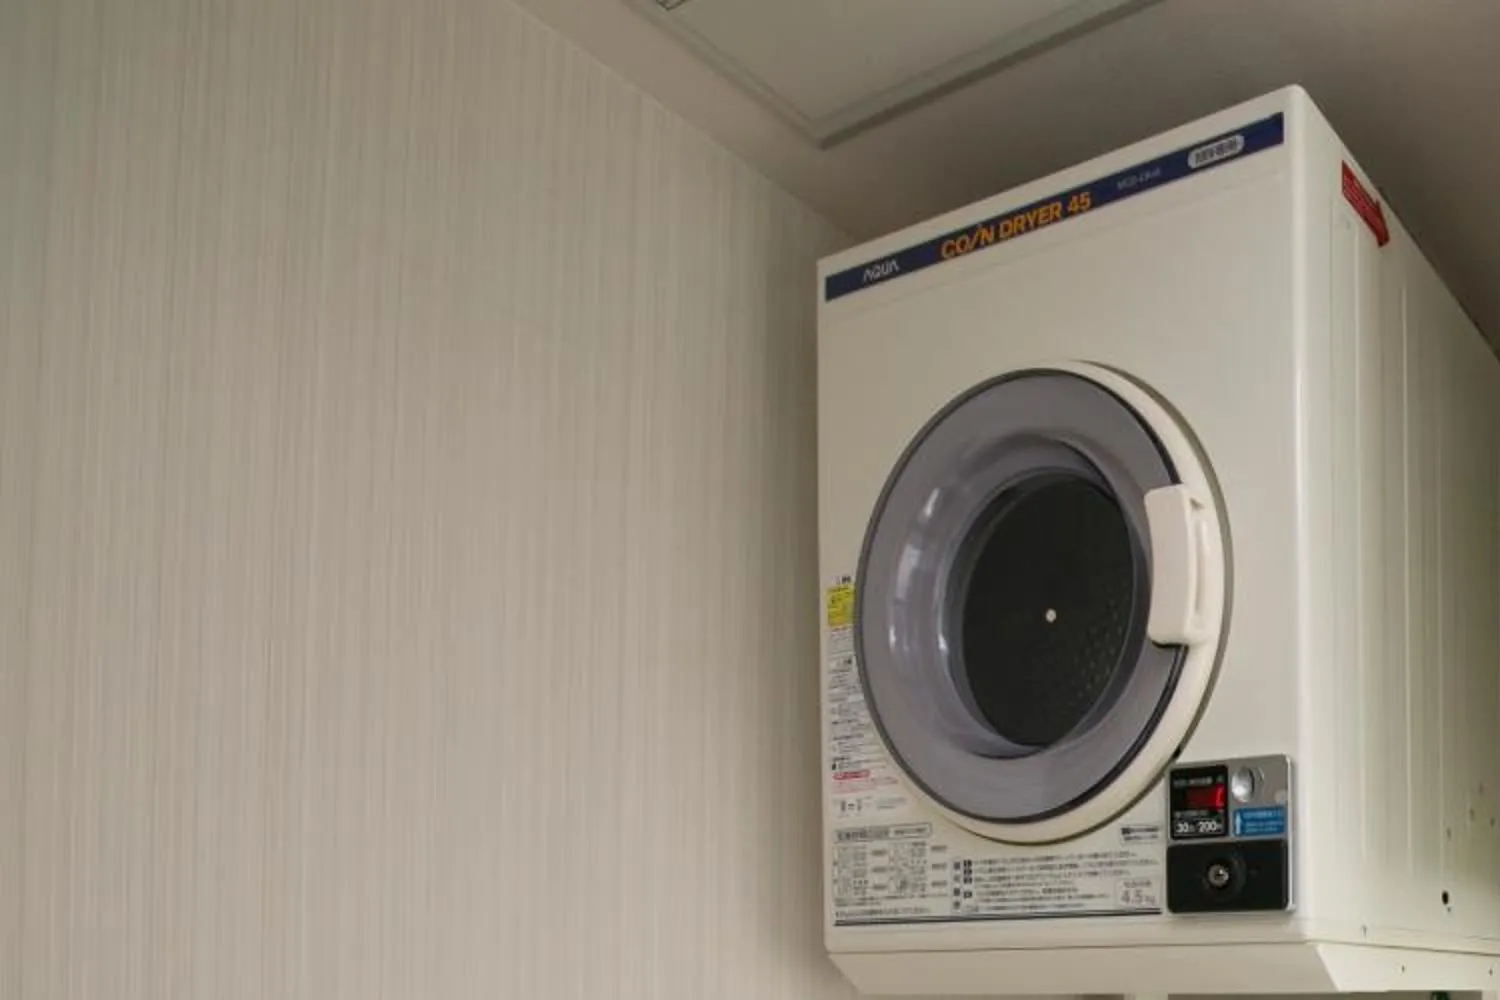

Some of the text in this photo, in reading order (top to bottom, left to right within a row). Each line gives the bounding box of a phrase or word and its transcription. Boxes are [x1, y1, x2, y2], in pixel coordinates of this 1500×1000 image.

[1000, 200, 1063, 239] DRYER
[1067, 190, 1092, 213] 45
[862, 258, 900, 283] AQUA
